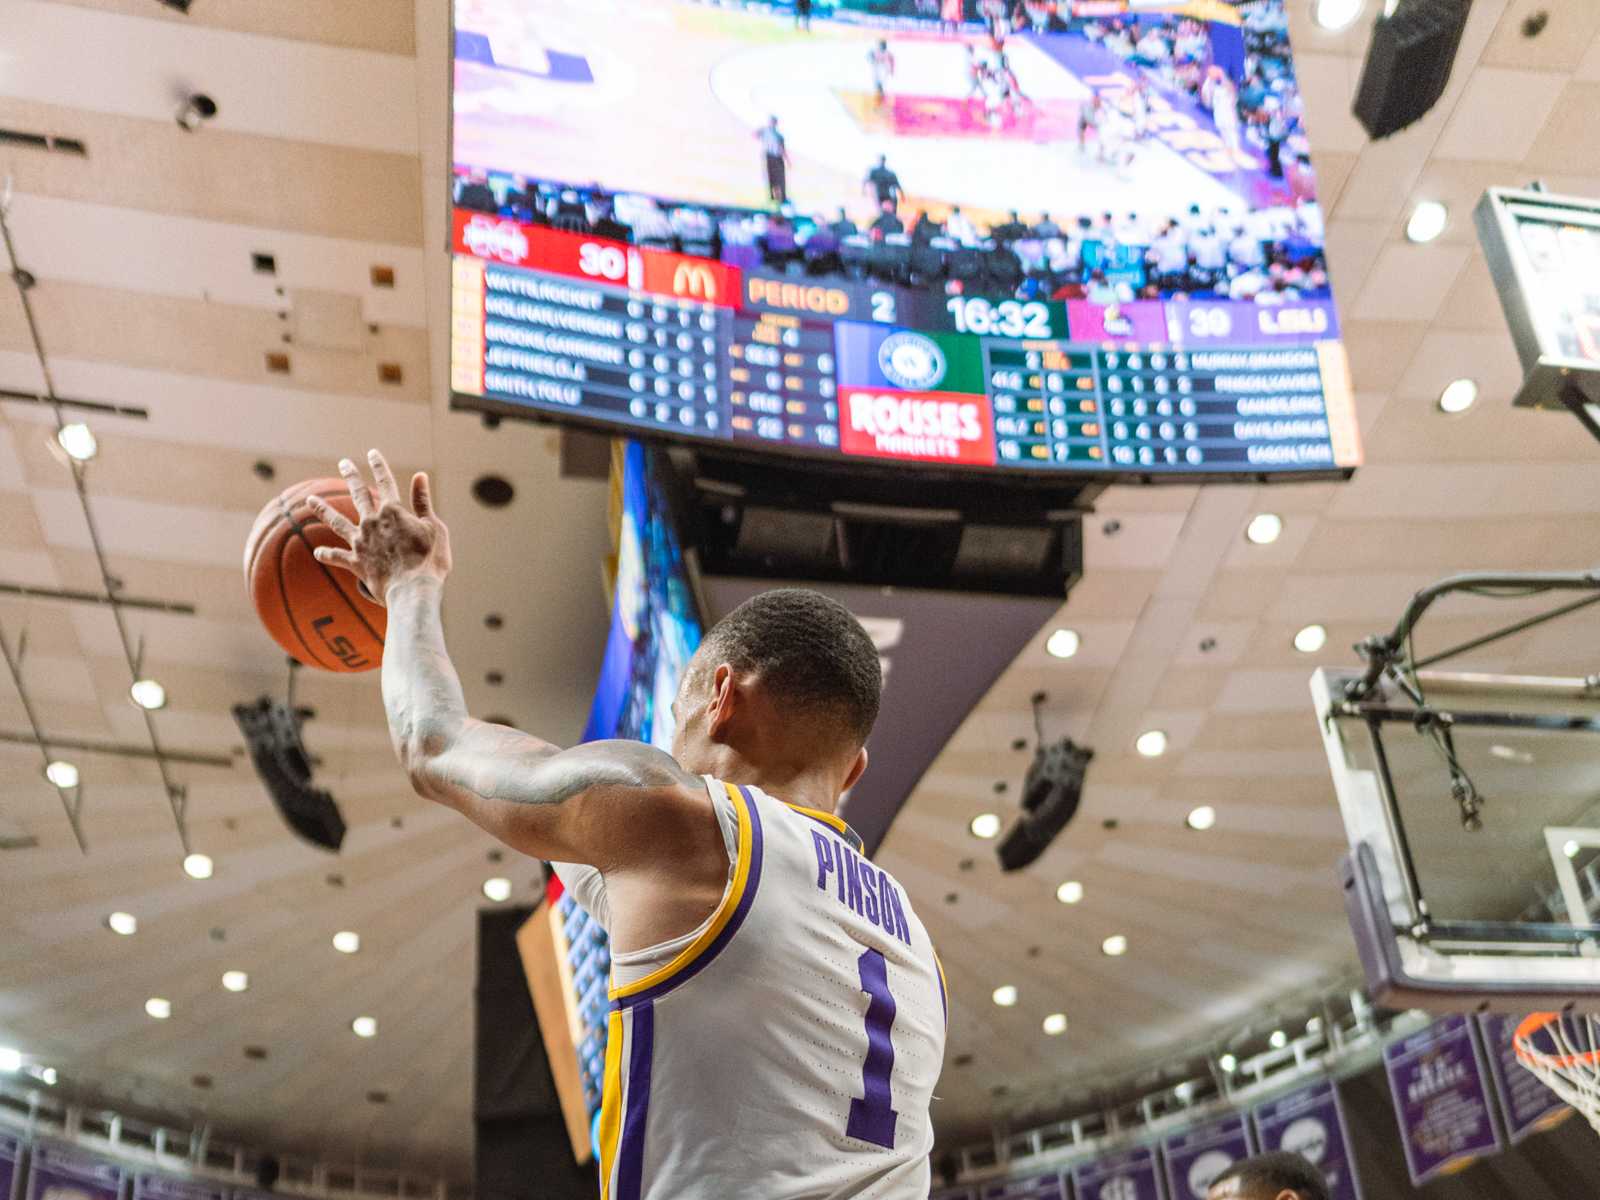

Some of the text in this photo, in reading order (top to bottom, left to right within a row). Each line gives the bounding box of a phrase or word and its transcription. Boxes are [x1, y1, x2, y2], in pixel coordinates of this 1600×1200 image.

[579, 242, 627, 280] 30
[749, 277, 849, 316] PERIOD
[871, 291, 896, 323] 2
[946, 296, 1052, 338] 16:32
[1258, 306, 1328, 335] LSU
[849, 393, 983, 441] ROUSES
[312, 615, 369, 669] LSU
[810, 828, 911, 946] PINSON
[846, 947, 898, 1149] 1
